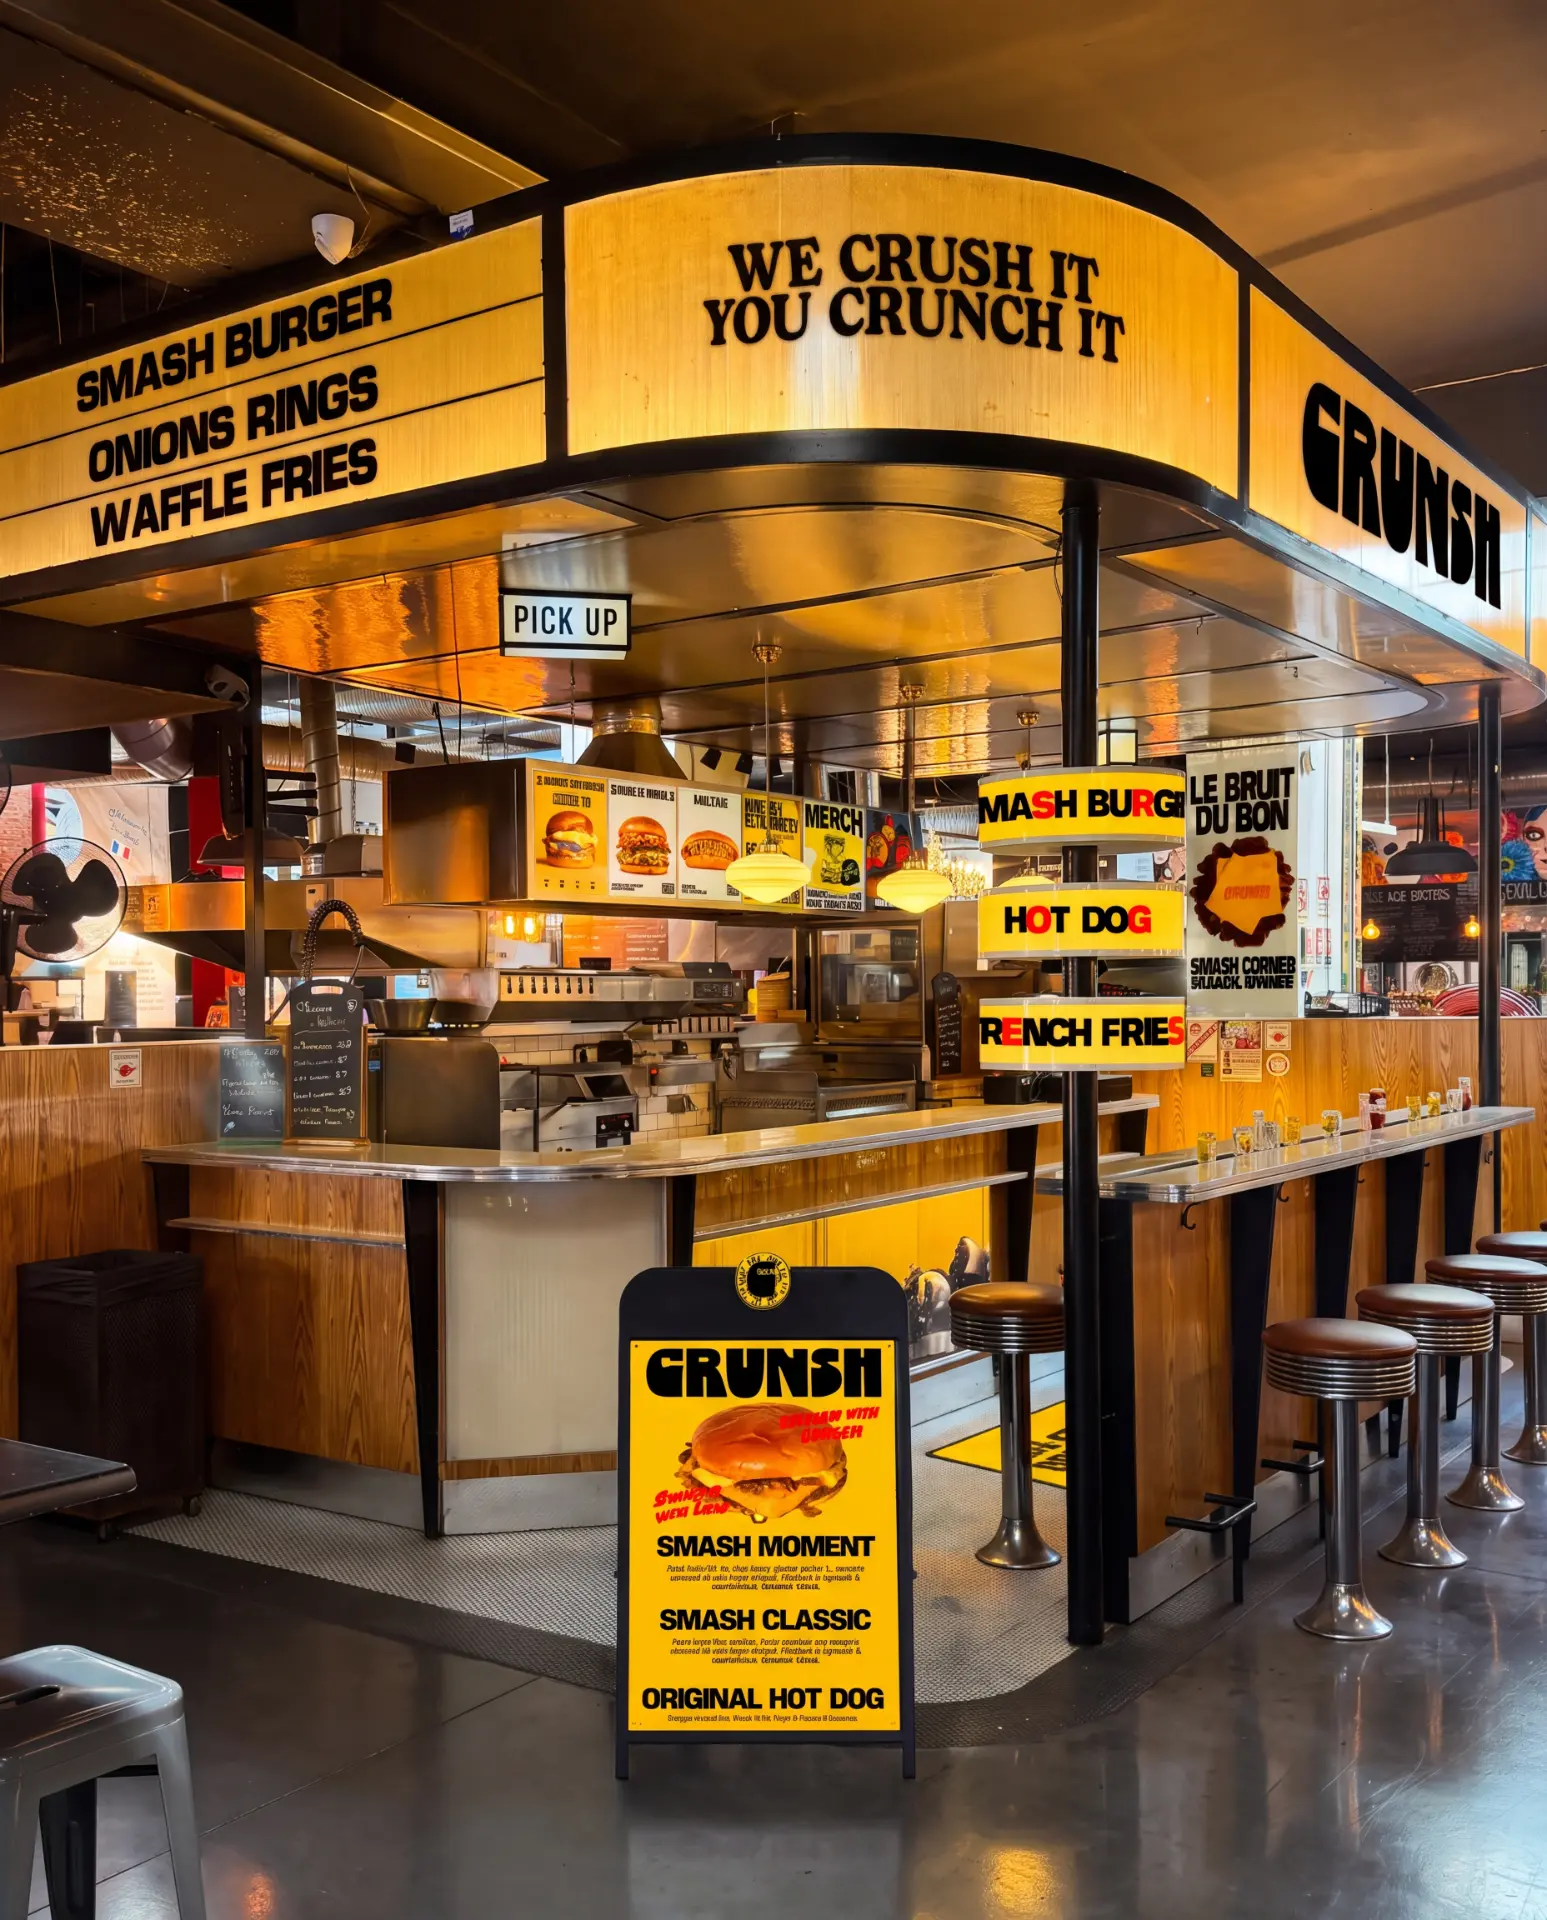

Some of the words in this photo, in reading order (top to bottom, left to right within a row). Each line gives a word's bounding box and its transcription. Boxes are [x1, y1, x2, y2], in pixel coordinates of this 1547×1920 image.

[727, 236, 823, 292] WE
[839, 233, 1033, 293] CRUSH
[1050, 250, 1099, 304] IT
[703, 291, 812, 346] YOU
[829, 286, 1063, 352] CRUNCH
[1078, 308, 1125, 363] IT
[76, 332, 215, 413] SMASH
[225, 277, 393, 368] BURGER
[88, 405, 235, 482] ONIONS
[247, 364, 378, 441] RINGS
[90, 469, 247, 547] WAFFLE
[261, 437, 378, 507] FRIES
[1302, 382, 1502, 610] GRUNSH
[514, 604, 574, 635] PICK
[586, 607, 618, 636] UP
[1190, 773, 1218, 805] LE
[1224, 767, 1295, 803] BRUIT
[804, 803, 864, 839] MERCH
[1195, 803, 1229, 835] DU
[1235, 799, 1289, 833] BON
[1004, 905, 1070, 934] HOT
[1082, 905, 1152, 934] DOG
[1190, 956, 1239, 975] SMASH
[1102, 1016, 1185, 1047] FRIES
[645, 1347, 882, 1398] GRUNSH
[657, 1535, 751, 1557] SMASH
[758, 1535, 875, 1557] MOMENT
[659, 1608, 755, 1631] SMASH
[762, 1608, 872, 1631] CLASSIC
[641, 1687, 763, 1710] ORIGINAL
[769, 1687, 822, 1709] HOT
[830, 1687, 884, 1709] DOG
